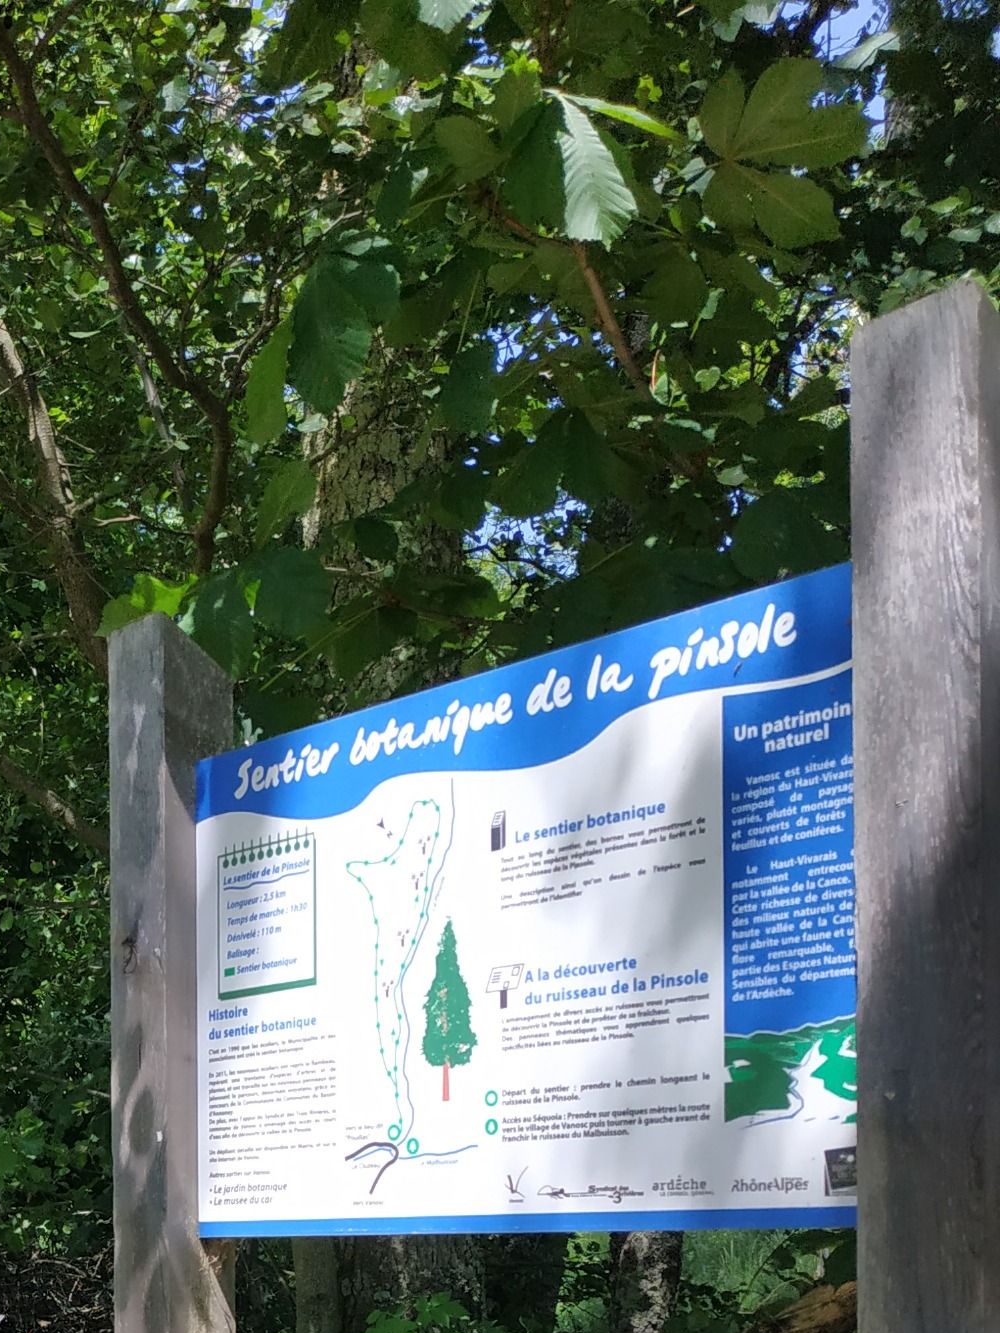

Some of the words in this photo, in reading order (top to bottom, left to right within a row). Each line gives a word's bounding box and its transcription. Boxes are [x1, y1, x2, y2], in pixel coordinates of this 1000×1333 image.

[234, 742, 340, 800] Sentier
[349, 692, 514, 766] botanique
[526, 668, 573, 716] de
[586, 654, 634, 700] la
[734, 724, 759, 742] Un
[761, 701, 853, 740] patrimoin
[764, 722, 829, 753] naturel
[840, 755, 853, 766] da
[800, 795, 853, 813] montagne
[515, 831, 531, 844] Le
[534, 819, 584, 840] sentier
[586, 803, 666, 829] botanique
[223, 876, 232, 886] Le
[233, 870, 260, 884] sentier
[261, 866, 271, 877] de
[272, 864, 280, 875] la
[281, 858, 311, 872] Pinsole
[807, 862, 853, 877] entrecou
[236, 963, 261, 975] Sentier
[261, 958, 298, 970] botanique
[525, 970, 534, 983] A
[538, 968, 550, 981] la
[553, 957, 637, 979] découverte
[525, 991, 542, 1005] du
[546, 986, 607, 1002] ruisseau
[611, 980, 630, 995] de
[633, 977, 647, 992] la
[651, 969, 709, 990] Pinsole
[209, 1005, 248, 1022] Histoire
[208, 1027, 222, 1041] du
[223, 1023, 259, 1038] sentier
[261, 1017, 317, 1033] botanique
